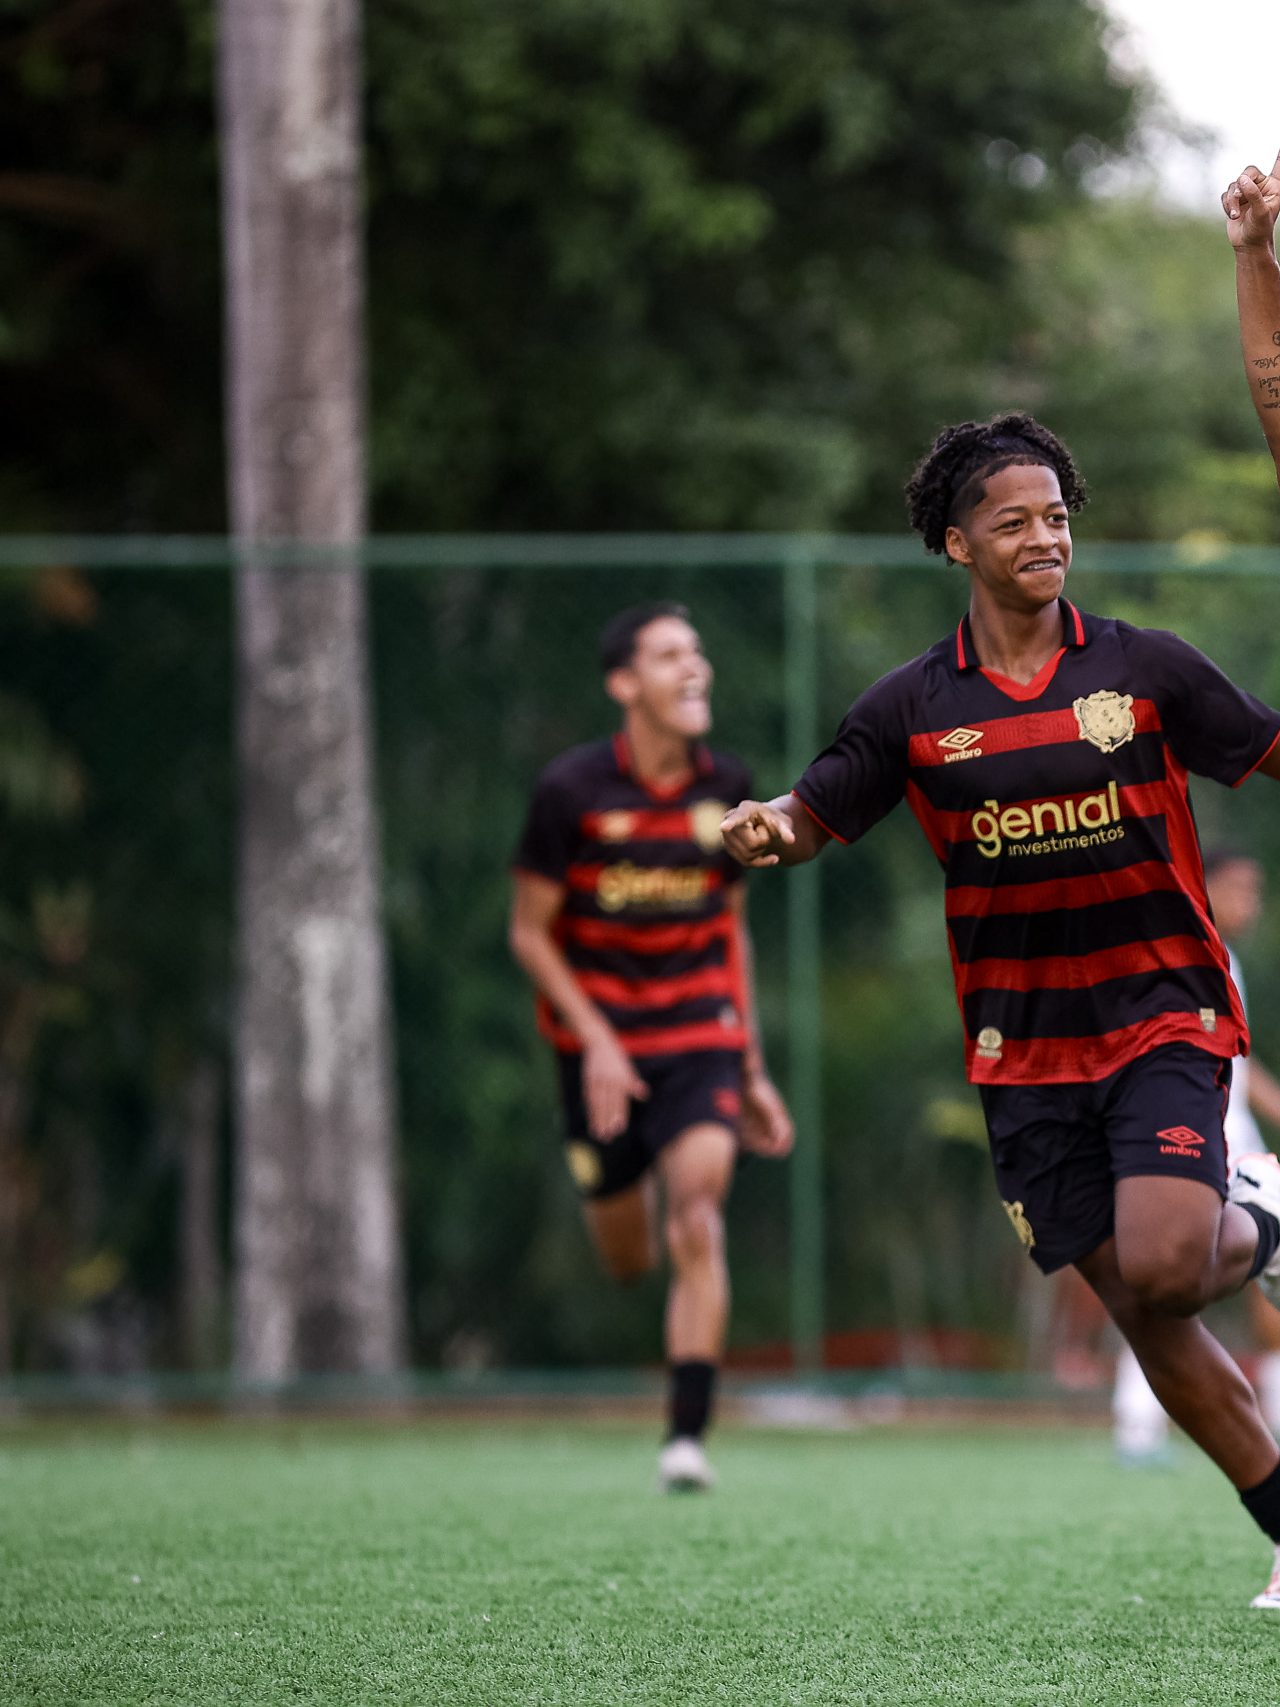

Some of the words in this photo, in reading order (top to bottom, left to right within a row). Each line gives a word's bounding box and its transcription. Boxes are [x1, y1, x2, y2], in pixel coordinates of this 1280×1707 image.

[944, 747, 983, 765] umbro
[972, 780, 1121, 858] genial
[1007, 826, 1125, 857] investimentos
[1160, 1143, 1201, 1158] umbro
